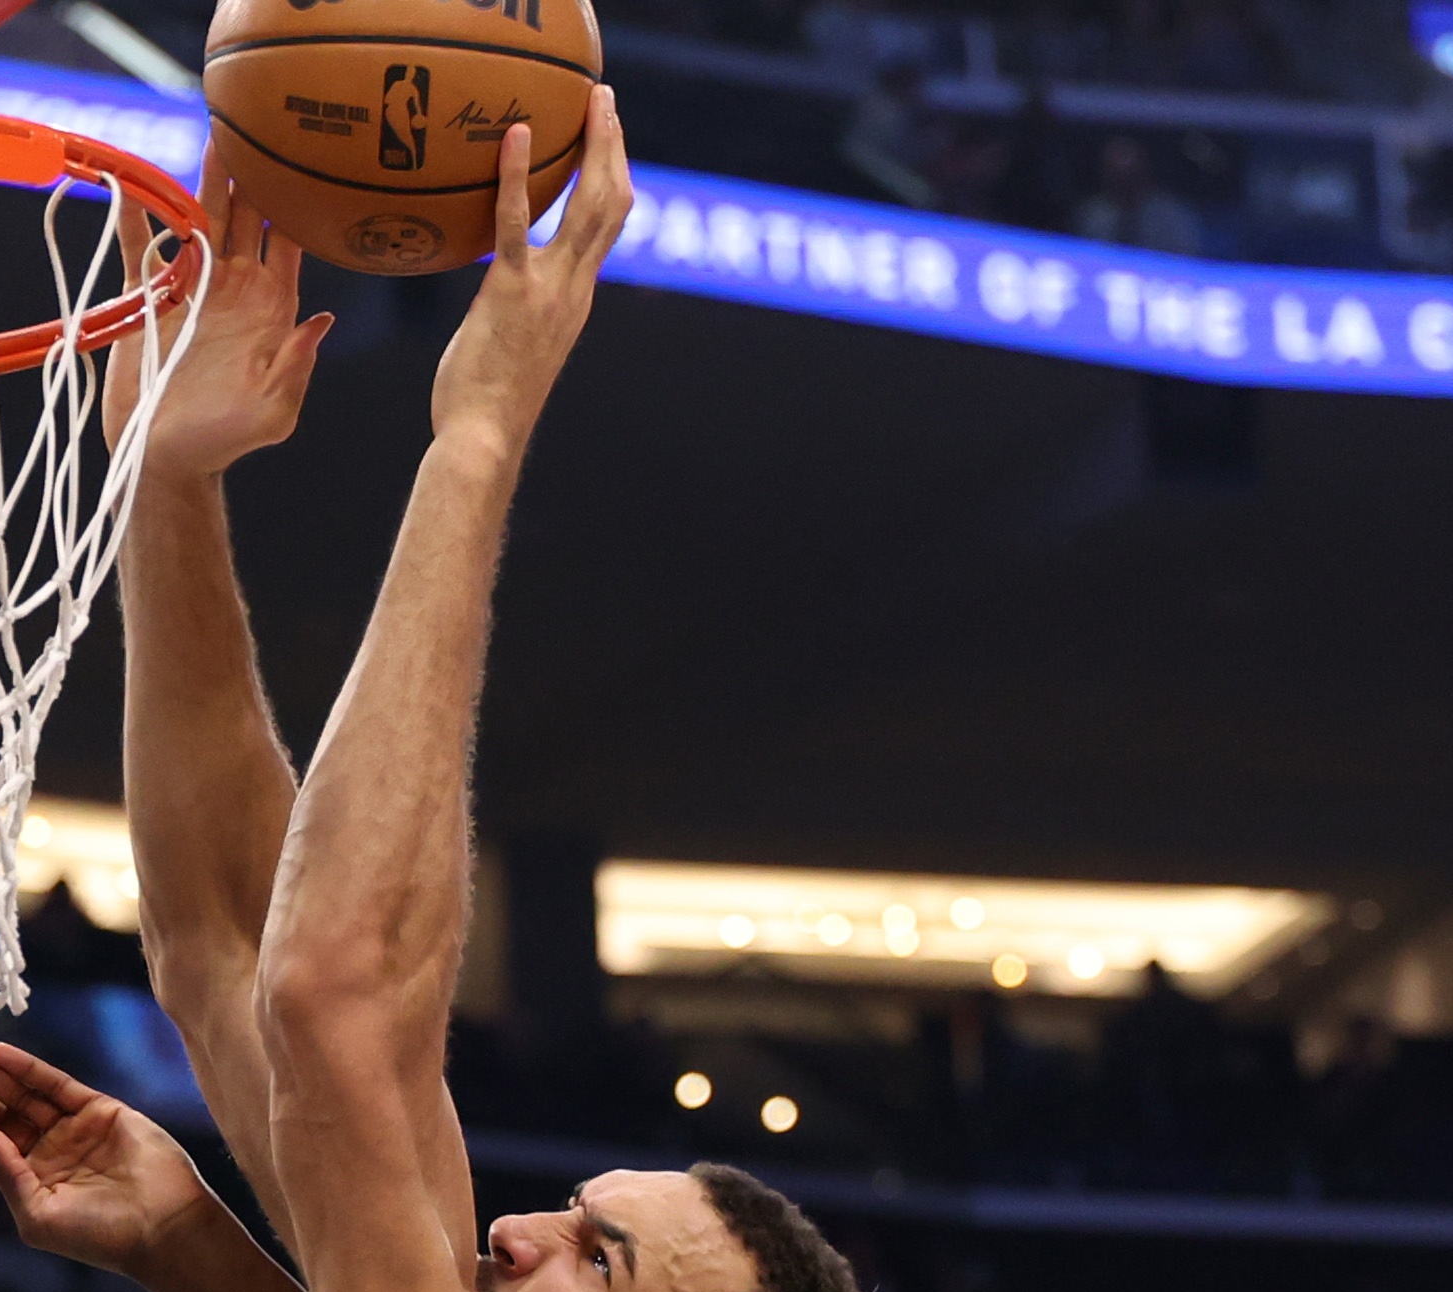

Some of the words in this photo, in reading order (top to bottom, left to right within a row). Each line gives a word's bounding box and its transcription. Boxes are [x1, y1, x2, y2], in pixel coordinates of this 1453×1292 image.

[978, 251, 1079, 329] OF
[1097, 270, 1249, 360] THE
[1273, 293, 1385, 368] LA
